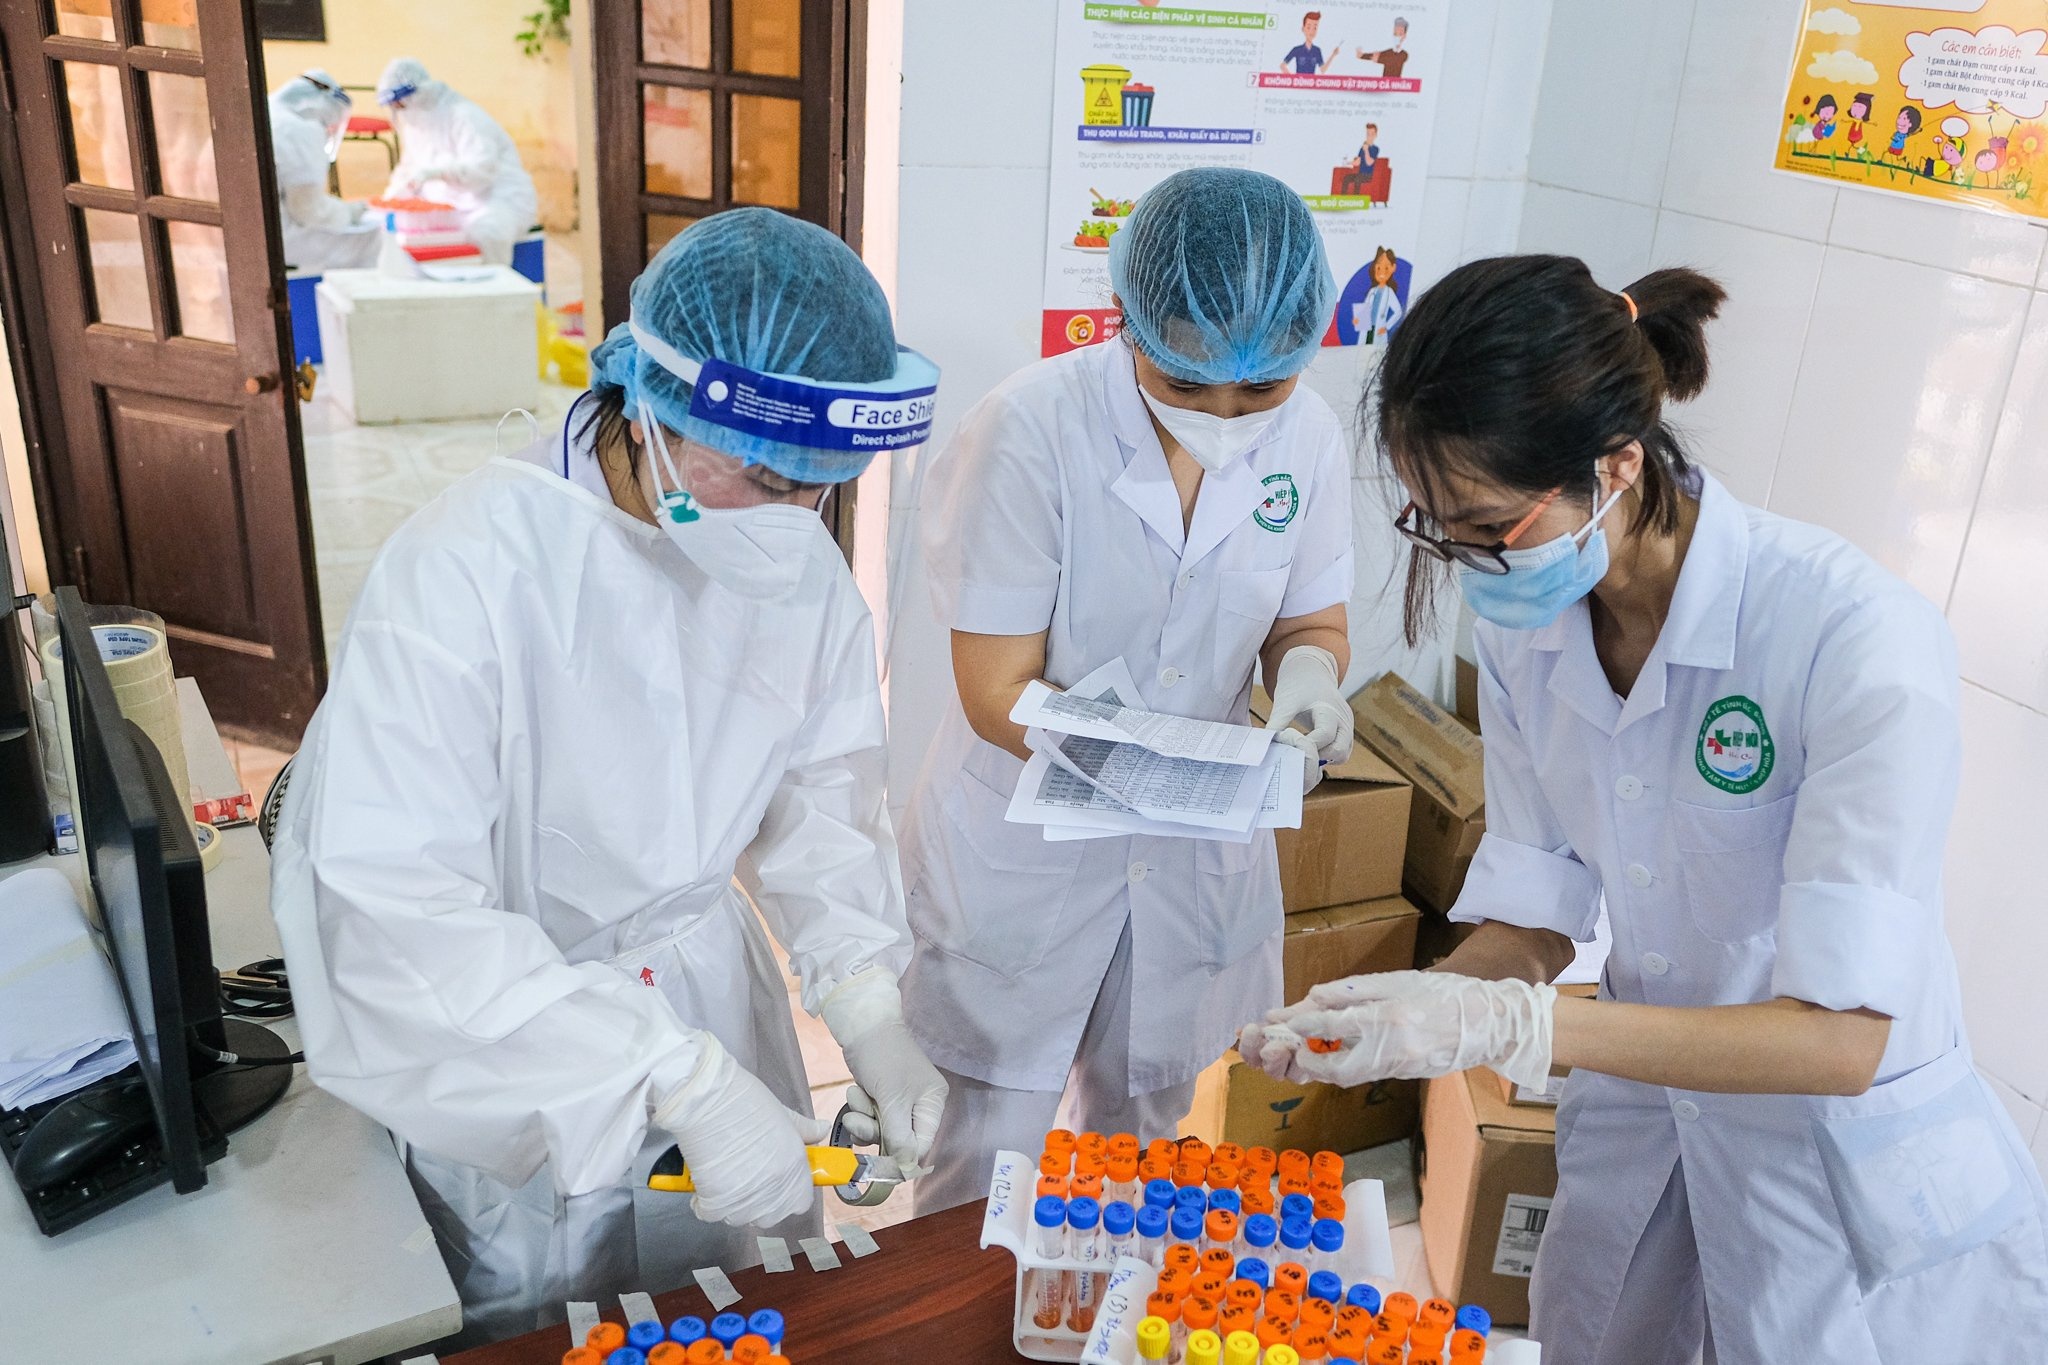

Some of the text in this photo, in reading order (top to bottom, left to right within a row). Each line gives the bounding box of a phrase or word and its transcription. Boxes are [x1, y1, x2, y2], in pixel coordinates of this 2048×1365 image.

[1088, 8, 1109, 18] THỰC
[1110, 9, 1130, 20] HIỆN
[1132, 9, 1150, 20] CÁC
[1152, 11, 1170, 22] BIỆN
[1172, 11, 1194, 22] PHÁP
[1196, 13, 1206, 24] VỆ
[1208, 14, 1226, 24] SINH
[1241, 15, 1263, 26] NHÂN
[1267, 17, 1274, 28] 6
[1941, 40, 1960, 52] Các
[1962, 45, 1976, 54] em
[1932, 58, 1946, 66] gam
[1947, 59, 1962, 67] chất
[1963, 60, 1978, 69] Đạm
[1980, 62, 1997, 72] cung
[1252, 75, 1257, 85] 7
[1265, 75, 1292, 86] KHÔNG
[1293, 76, 1314, 87] DÙNG
[1316, 78, 1341, 88] CHUNG
[1358, 79, 1378, 90] DỤNG
[1392, 79, 1412, 90] NHÂN
[1929, 69, 1943, 77] gam
[1944, 70, 1958, 78] chất
[1960, 71, 1972, 80] Bột
[1973, 73, 1996, 84] đường
[1998, 77, 2015, 86] cung
[2037, 80, 2047, 89] Kca
[1927, 81, 1941, 90] gam
[1942, 82, 1956, 91] chất
[1971, 87, 1988, 96] cung
[1084, 129, 1097, 137] THU
[1099, 130, 1117, 138] GOM
[1119, 127, 1138, 138] KHẨU
[1140, 130, 1166, 140] TRANG,
[1168, 130, 1188, 140] KHĂN
[1190, 129, 1208, 140] GIẤY
[1255, 132, 1262, 142] 8
[852, 398, 935, 425] Face Shie
[852, 432, 911, 446] Direct Splash
